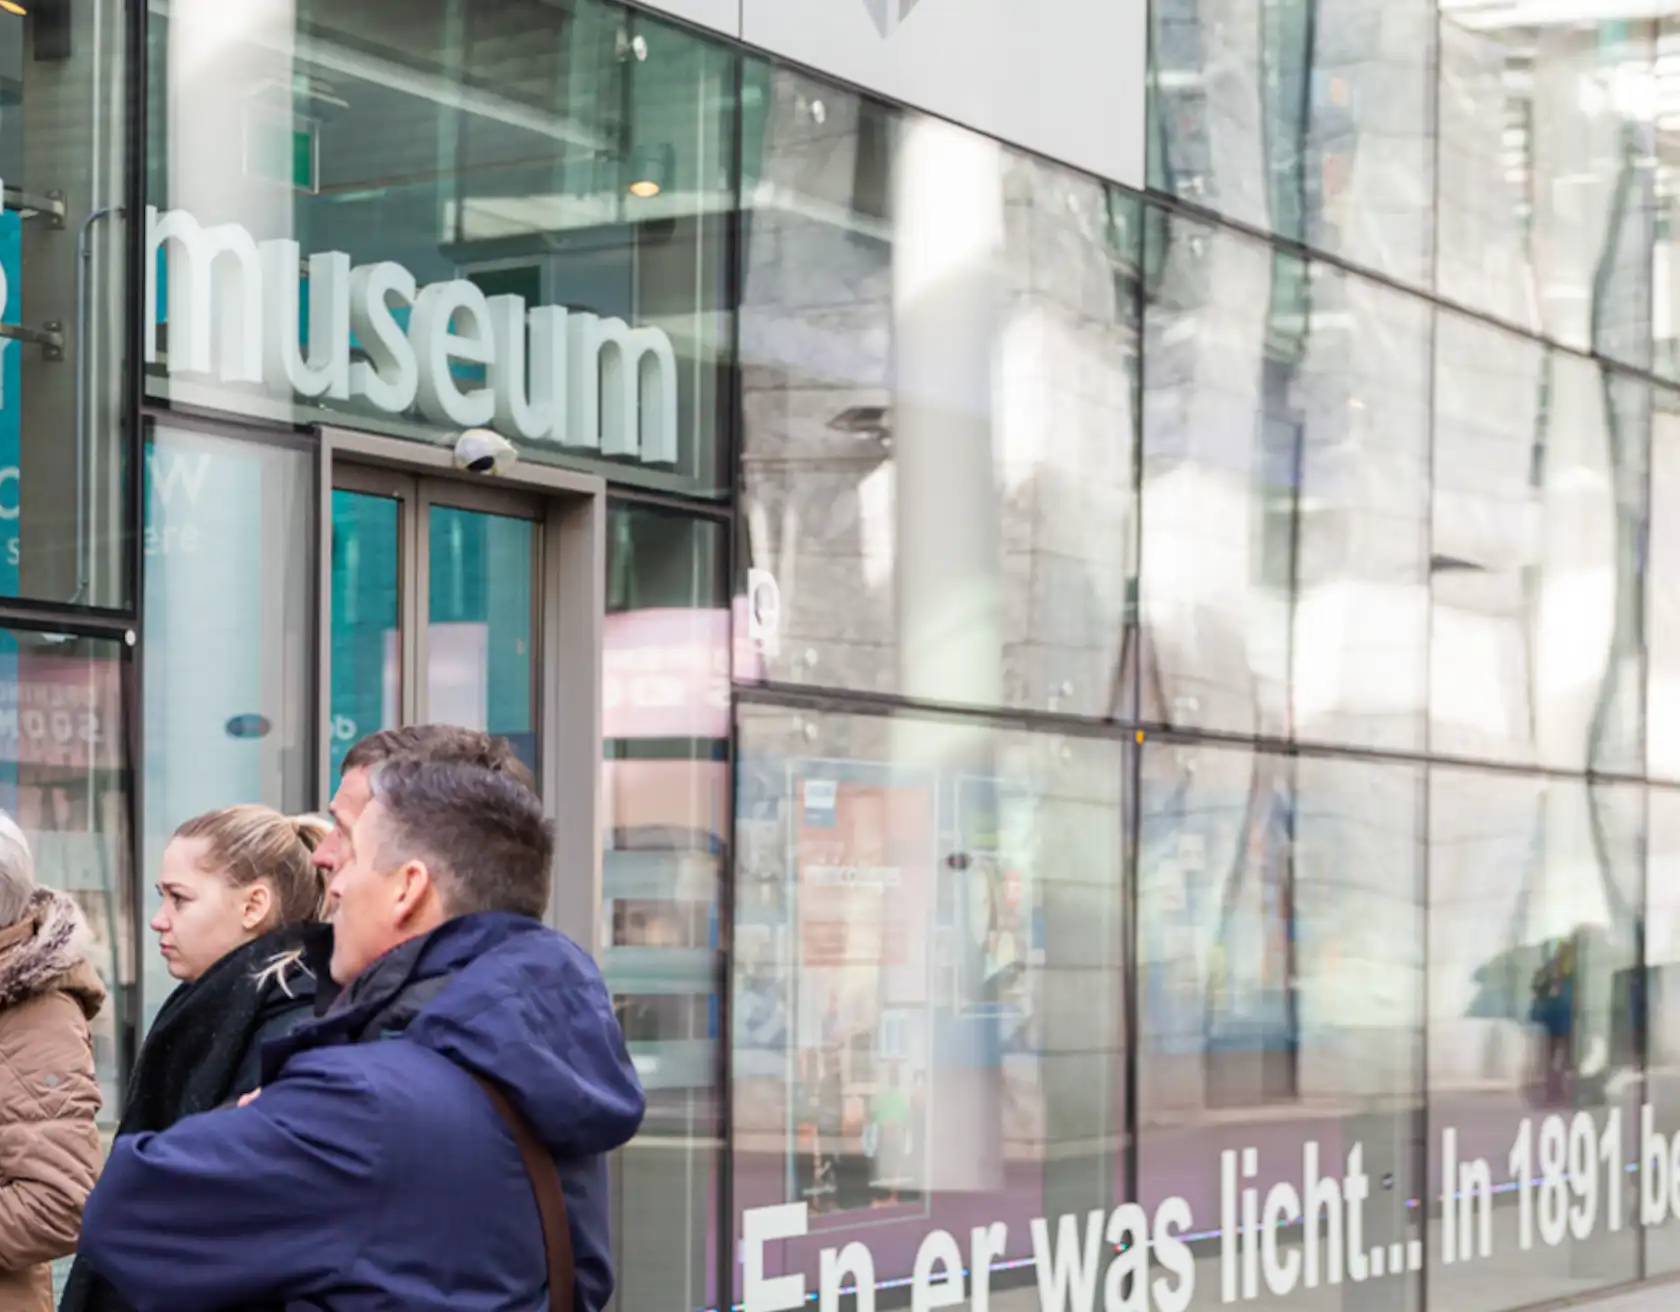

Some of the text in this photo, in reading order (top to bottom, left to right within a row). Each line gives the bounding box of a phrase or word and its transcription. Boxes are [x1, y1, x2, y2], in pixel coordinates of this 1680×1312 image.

[145, 204, 678, 464] museum
[743, 1201, 875, 1312] En
[912, 1221, 1008, 1312] er
[1031, 1196, 1196, 1312] was
[1221, 1140, 1422, 1304] licht...
[1441, 1126, 1492, 1264] In
[1508, 1106, 1621, 1251] 1891
